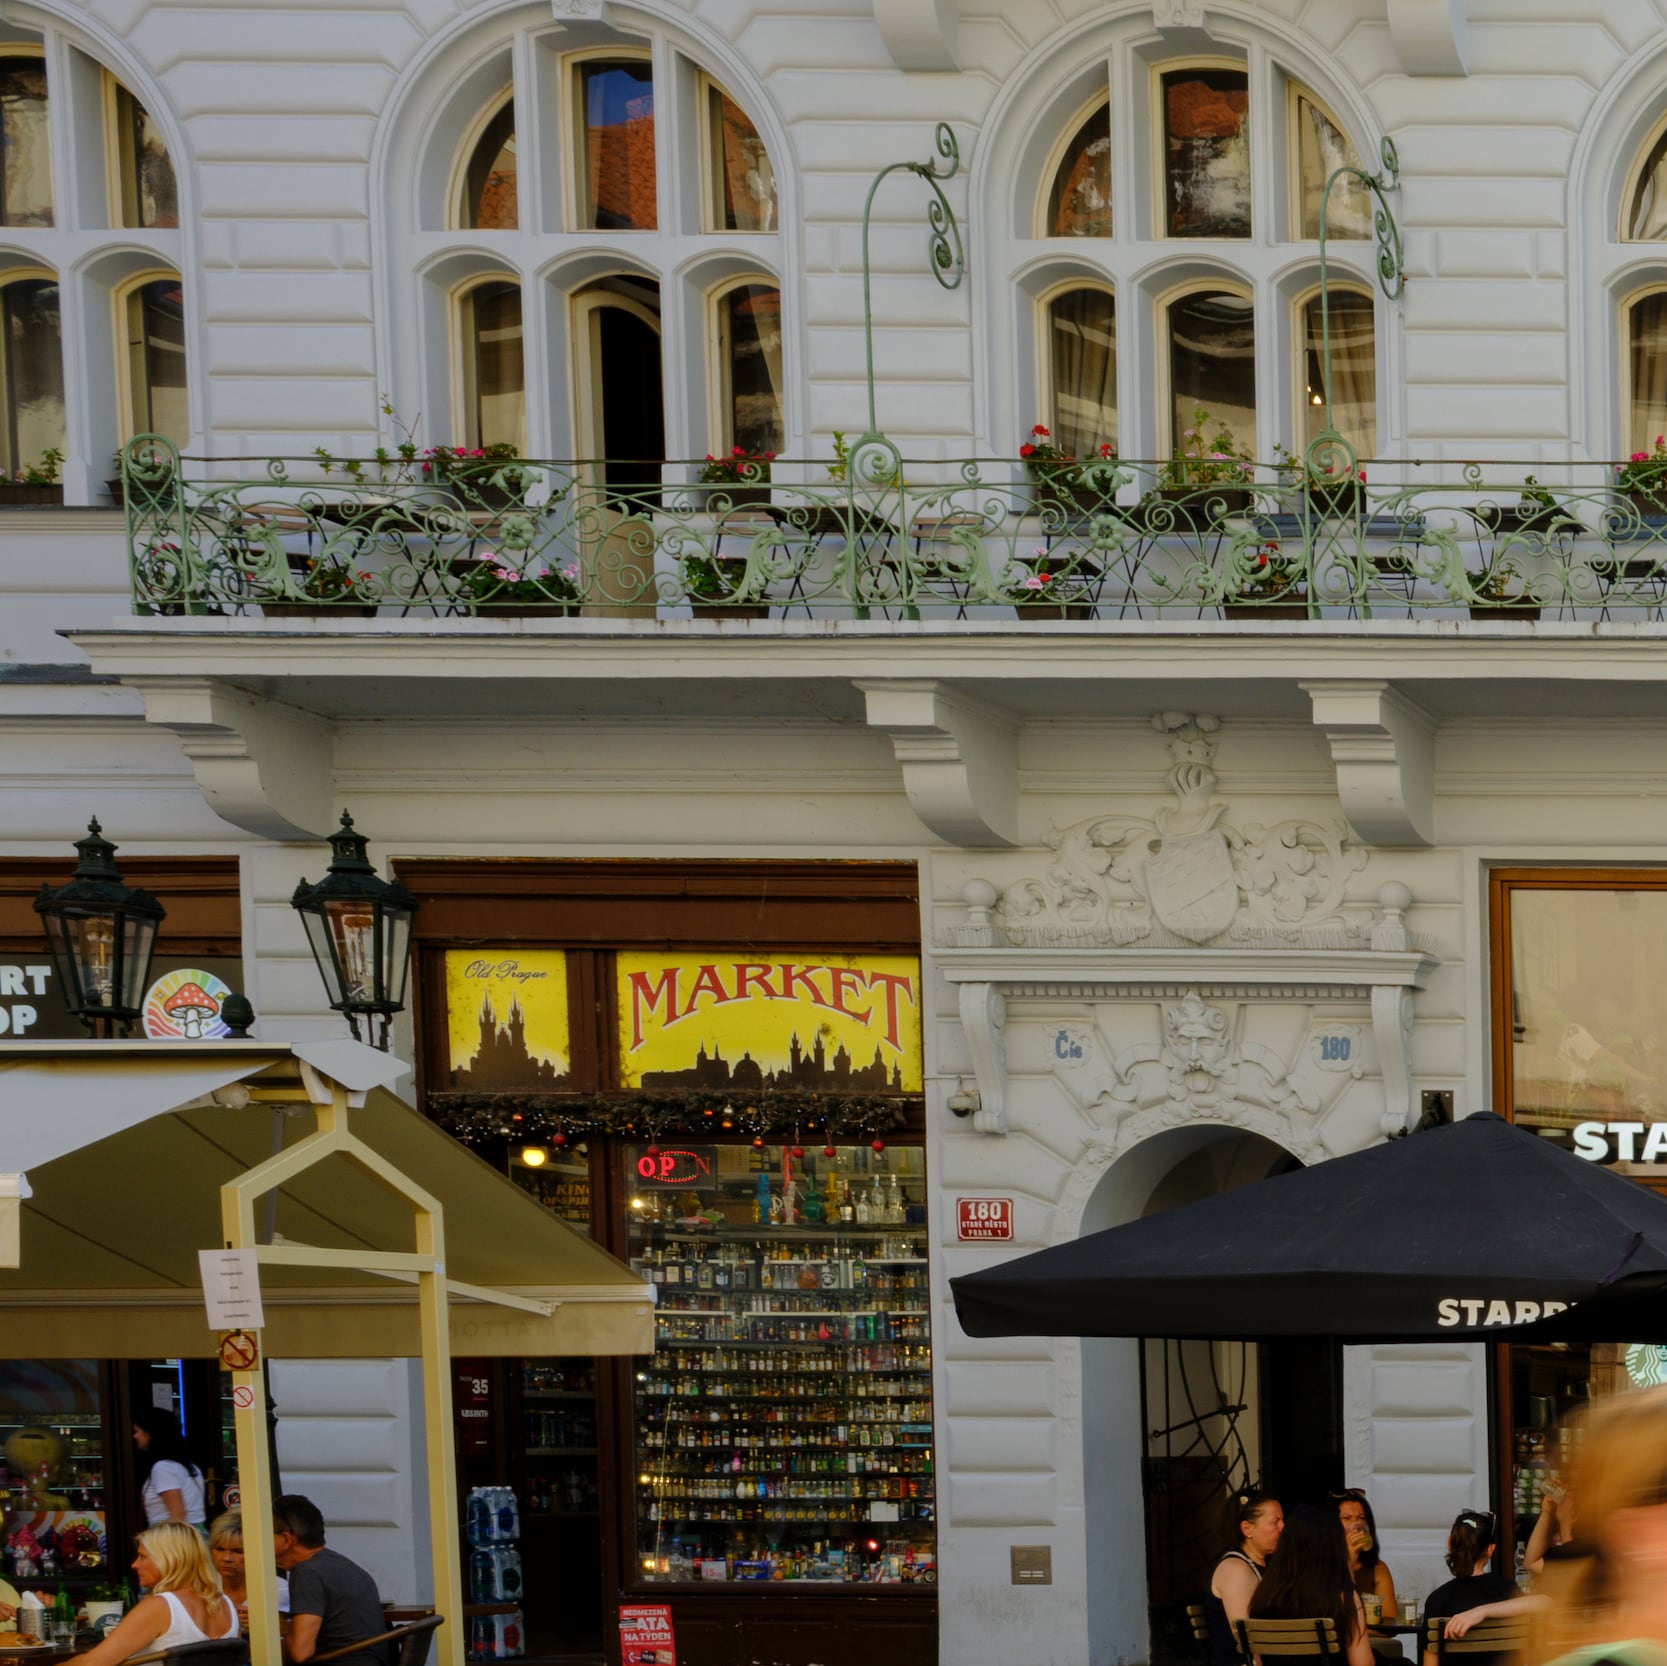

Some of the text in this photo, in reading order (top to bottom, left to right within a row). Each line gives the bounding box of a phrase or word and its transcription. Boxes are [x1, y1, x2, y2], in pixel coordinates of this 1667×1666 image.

[464, 960, 548, 984] Old Prague
[626, 963, 915, 1053] MARKET
[1320, 1034, 1352, 1062] 180
[556, 1184, 590, 1196] KIN
[968, 1202, 1001, 1220] 180
[962, 1219, 1008, 1228] STARÉ MĚSTO
[968, 1229, 993, 1237] PRAHA
[472, 1378, 489, 1395] 35
[635, 1616, 669, 1631] ATA
[624, 1631, 671, 1642] NA TÝDEN
